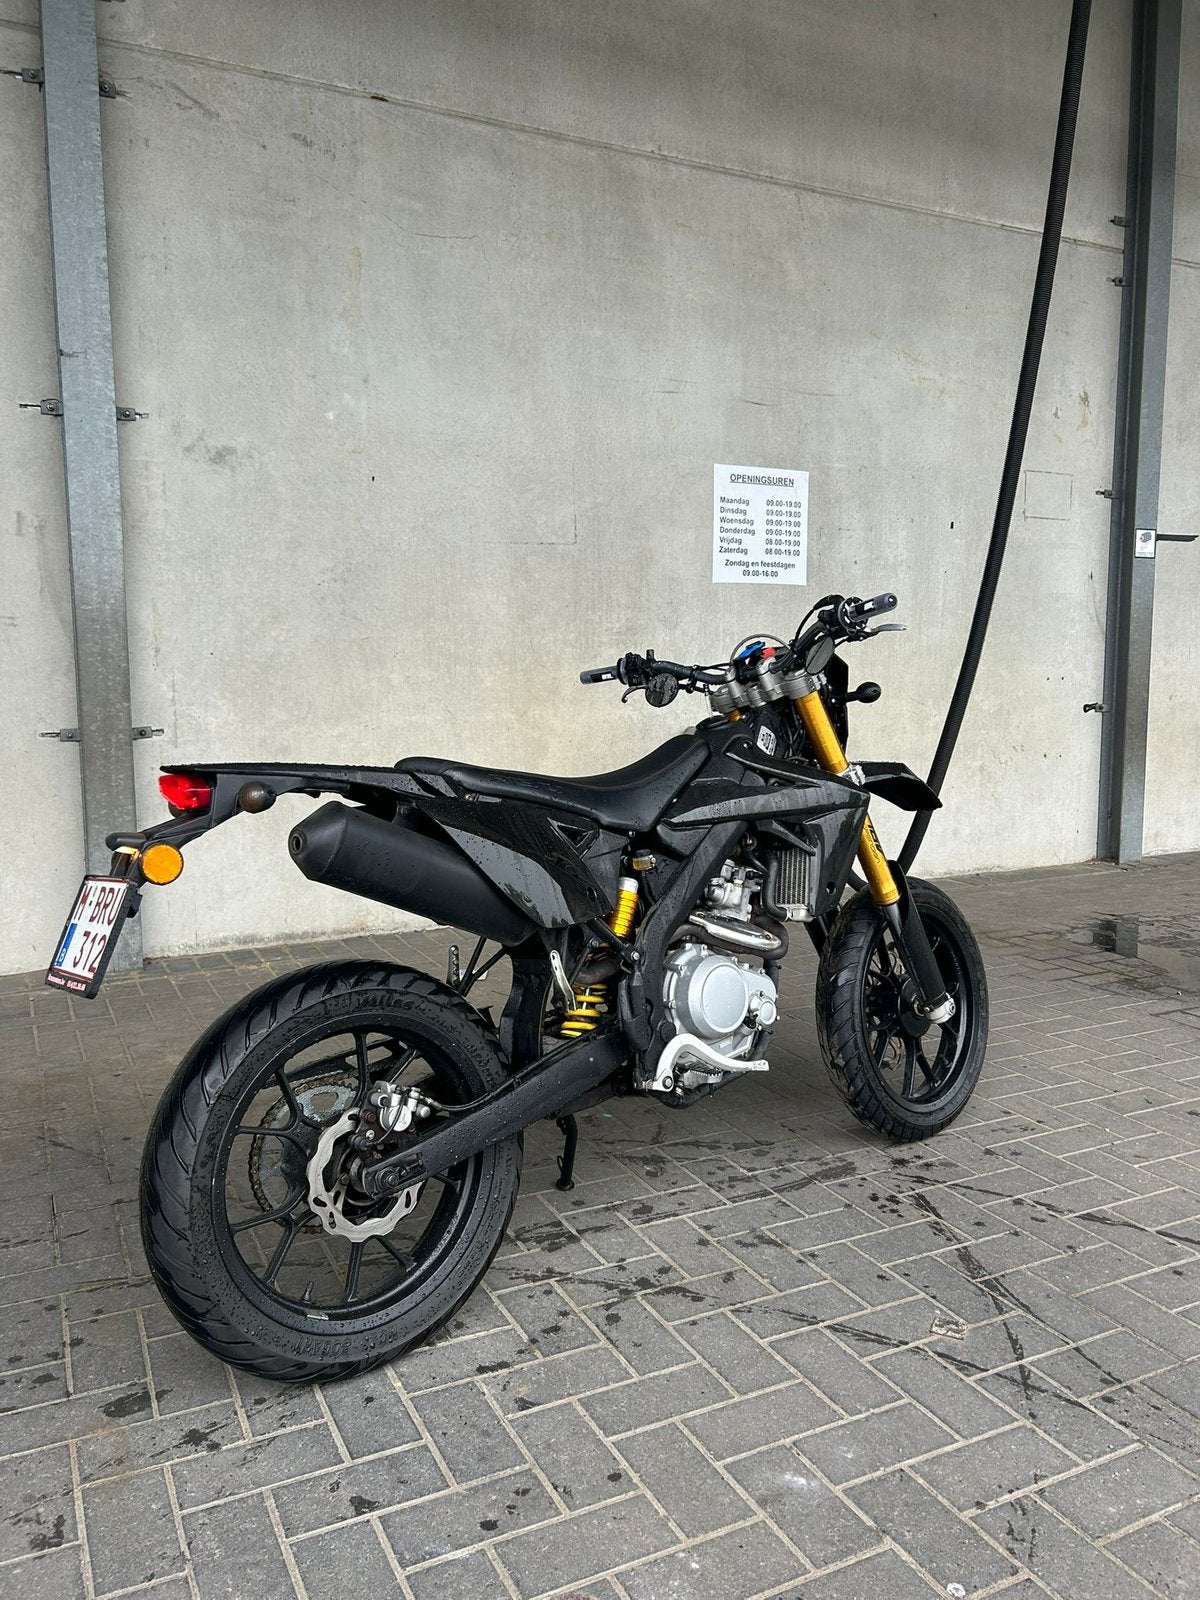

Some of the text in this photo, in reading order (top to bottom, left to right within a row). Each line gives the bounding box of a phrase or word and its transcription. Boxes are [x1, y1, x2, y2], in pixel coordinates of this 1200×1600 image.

[730, 473, 794, 487] OPENINGSUREN
[720, 496, 801, 508] Maandag 09.00-19.00
[720, 506, 801, 518] Dinsdag 09.00-19.00
[719, 516, 801, 527] Woensdag 09.00-19.00
[719, 526, 800, 537] Donderdag 09.00-19.00
[719, 536, 800, 547] Vrijdag 08.00-19.00
[719, 546, 800, 556] Zaterdag 08.00-19.00
[725, 559, 749, 568] Zondag
[760, 560, 795, 570] feestdagen
[742, 569, 778, 577] 09.00-16.00
[72, 931, 107, 974] 312
